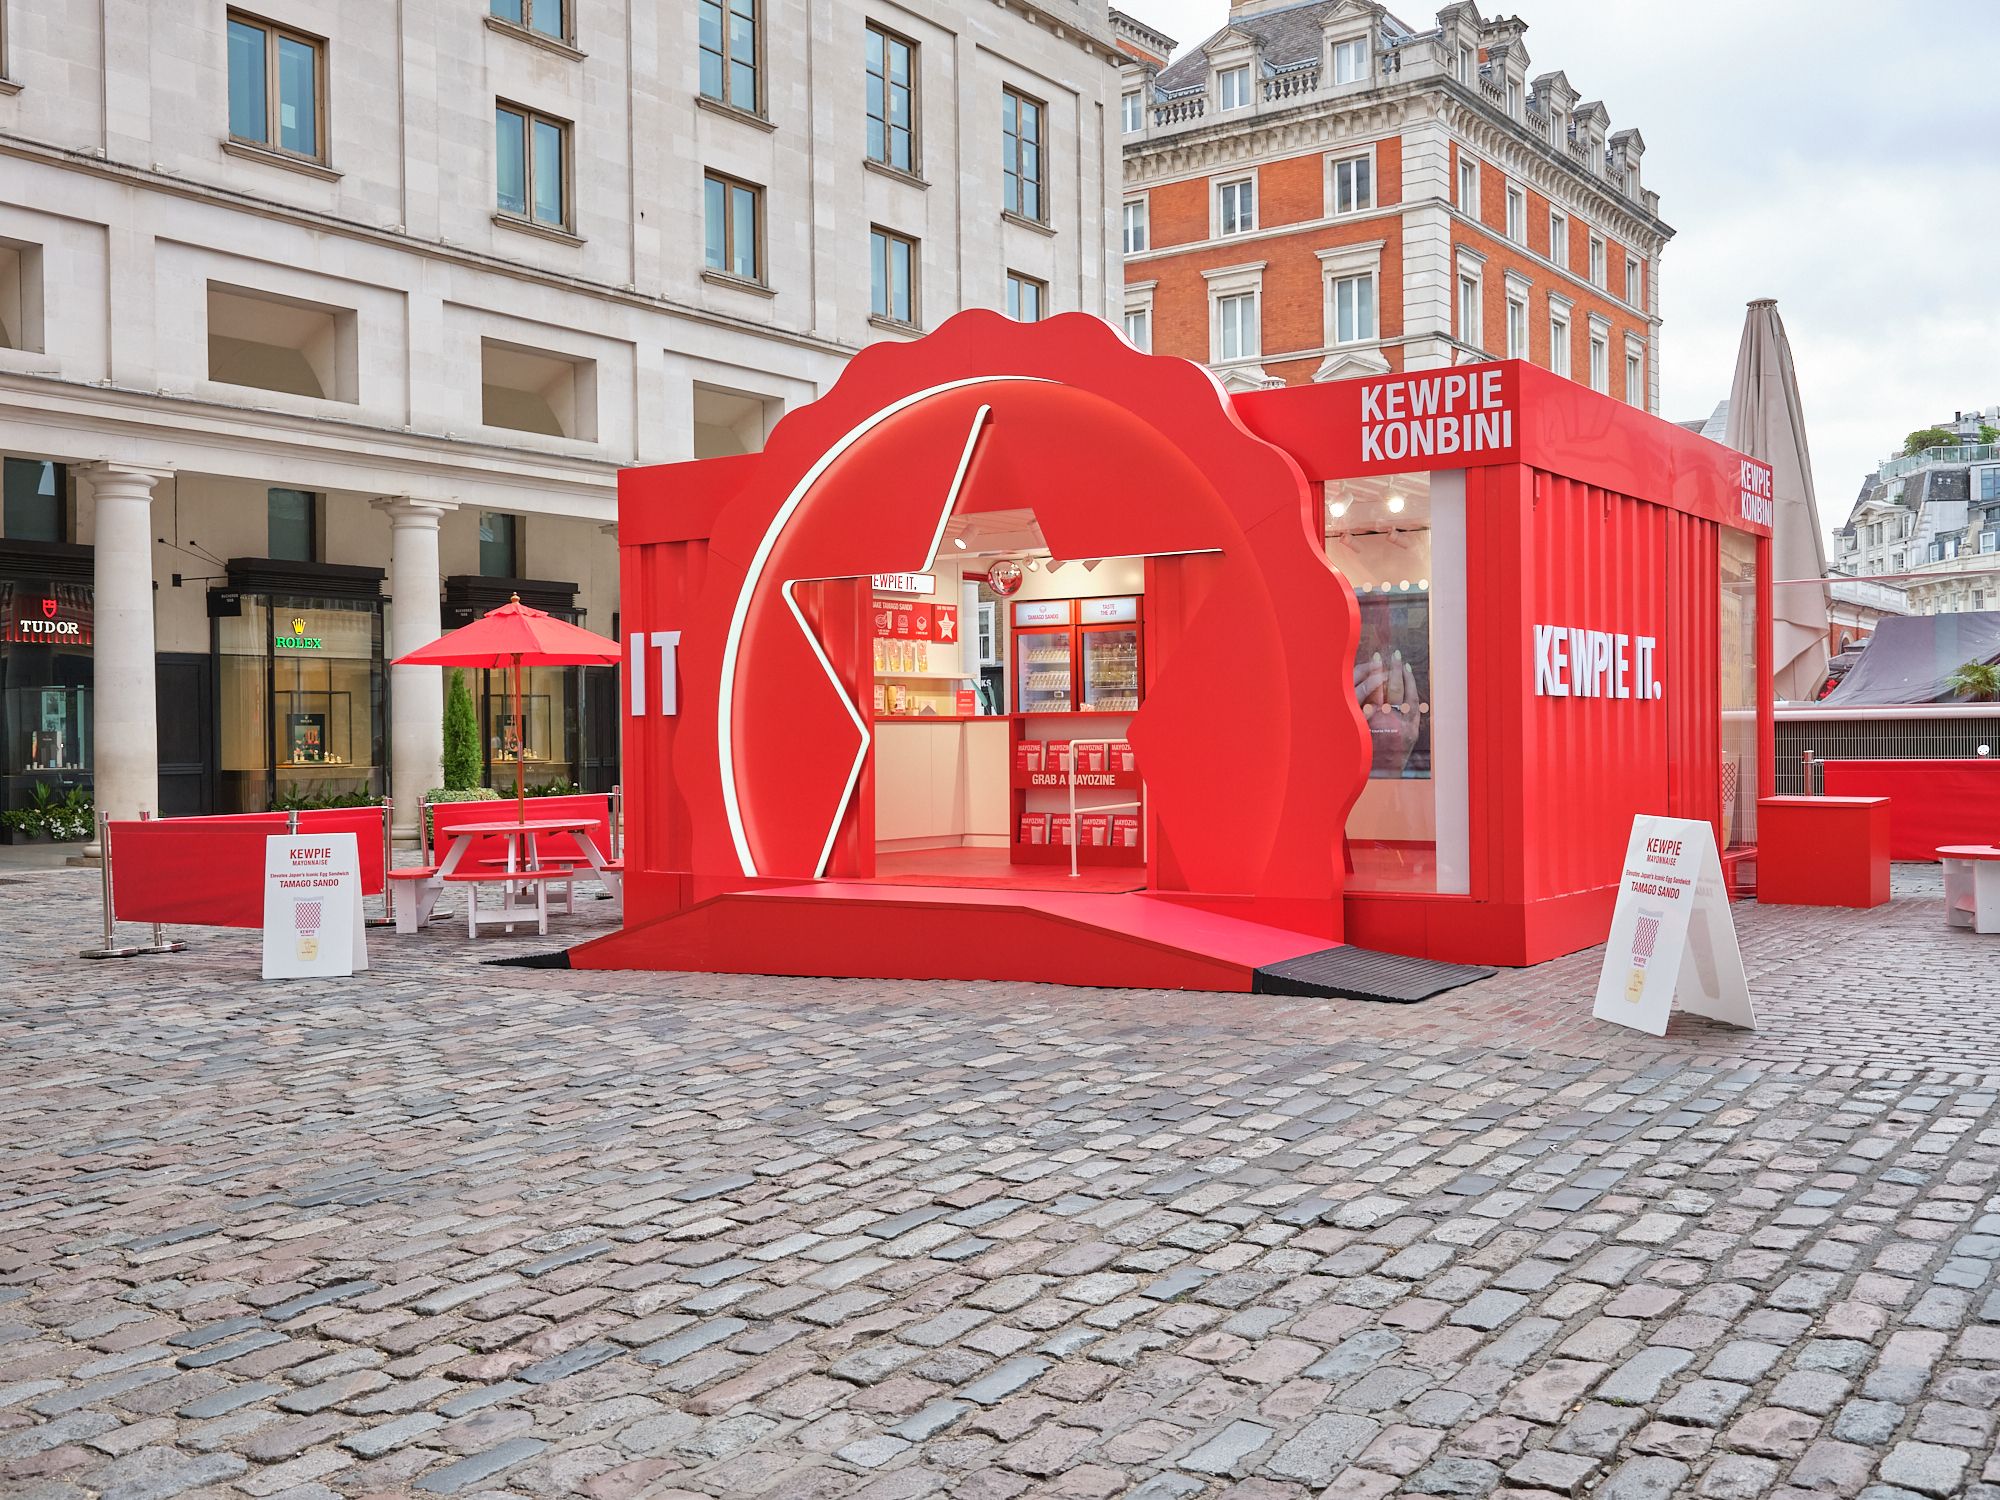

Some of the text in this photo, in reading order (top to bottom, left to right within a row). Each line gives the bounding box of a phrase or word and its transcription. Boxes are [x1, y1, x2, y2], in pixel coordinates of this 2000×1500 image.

[1361, 370, 1503, 422] KEWPIE
[1362, 410, 1511, 462] KONBINI
[1741, 460, 1770, 497] KEWPIE
[1741, 490, 1772, 527] KONBINI
[873, 575, 917, 590] EWPIE IT.
[20, 620, 79, 634] TUDOR
[275, 637, 322, 649] ROLEX
[1533, 624, 1662, 700] KEWPIE IT.
[630, 630, 682, 716] IT
[1032, 774, 1057, 785] GRAB
[1059, 774, 1066, 785] A
[290, 848, 331, 859] KEWPIE
[1646, 837, 1682, 856] KEWPIE
[1646, 854, 1677, 866] MAYONNAISE
[279, 878, 339, 888] TAMAGO SANDO
[1665, 875, 1673, 884] Egg
[1673, 877, 1691, 886] Sandwich
[1631, 881, 1657, 895] TAMAGO
[1657, 885, 1680, 899] SANDO
